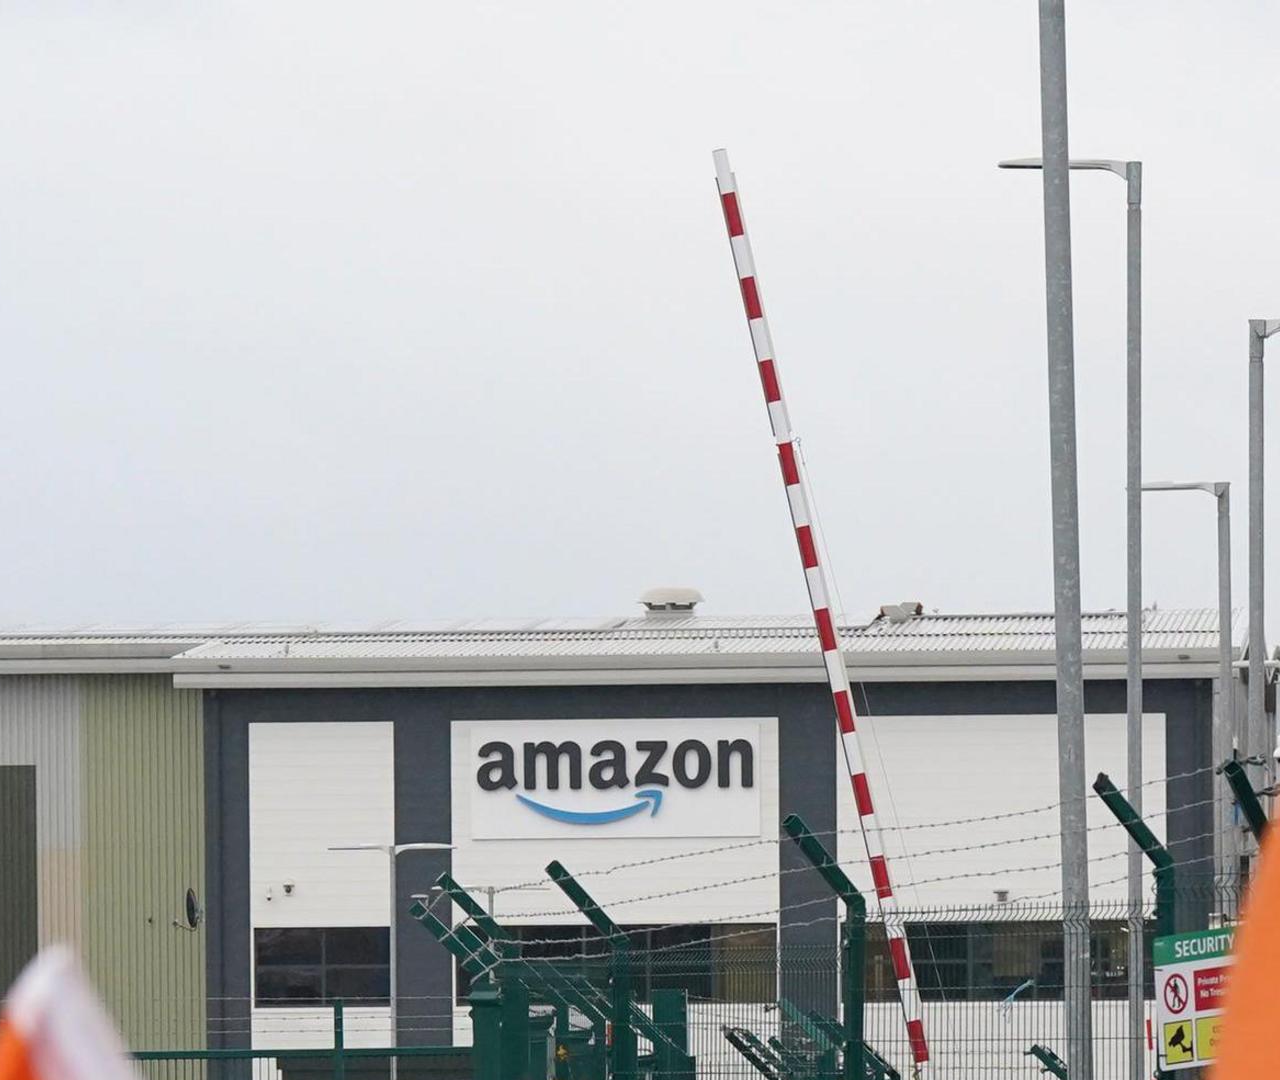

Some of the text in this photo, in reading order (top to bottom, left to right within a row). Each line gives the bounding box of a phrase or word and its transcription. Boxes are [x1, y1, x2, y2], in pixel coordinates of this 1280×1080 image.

[476, 739, 754, 791] amazon
[1175, 934, 1235, 958] SECURITY
[1200, 989, 1210, 999] No
